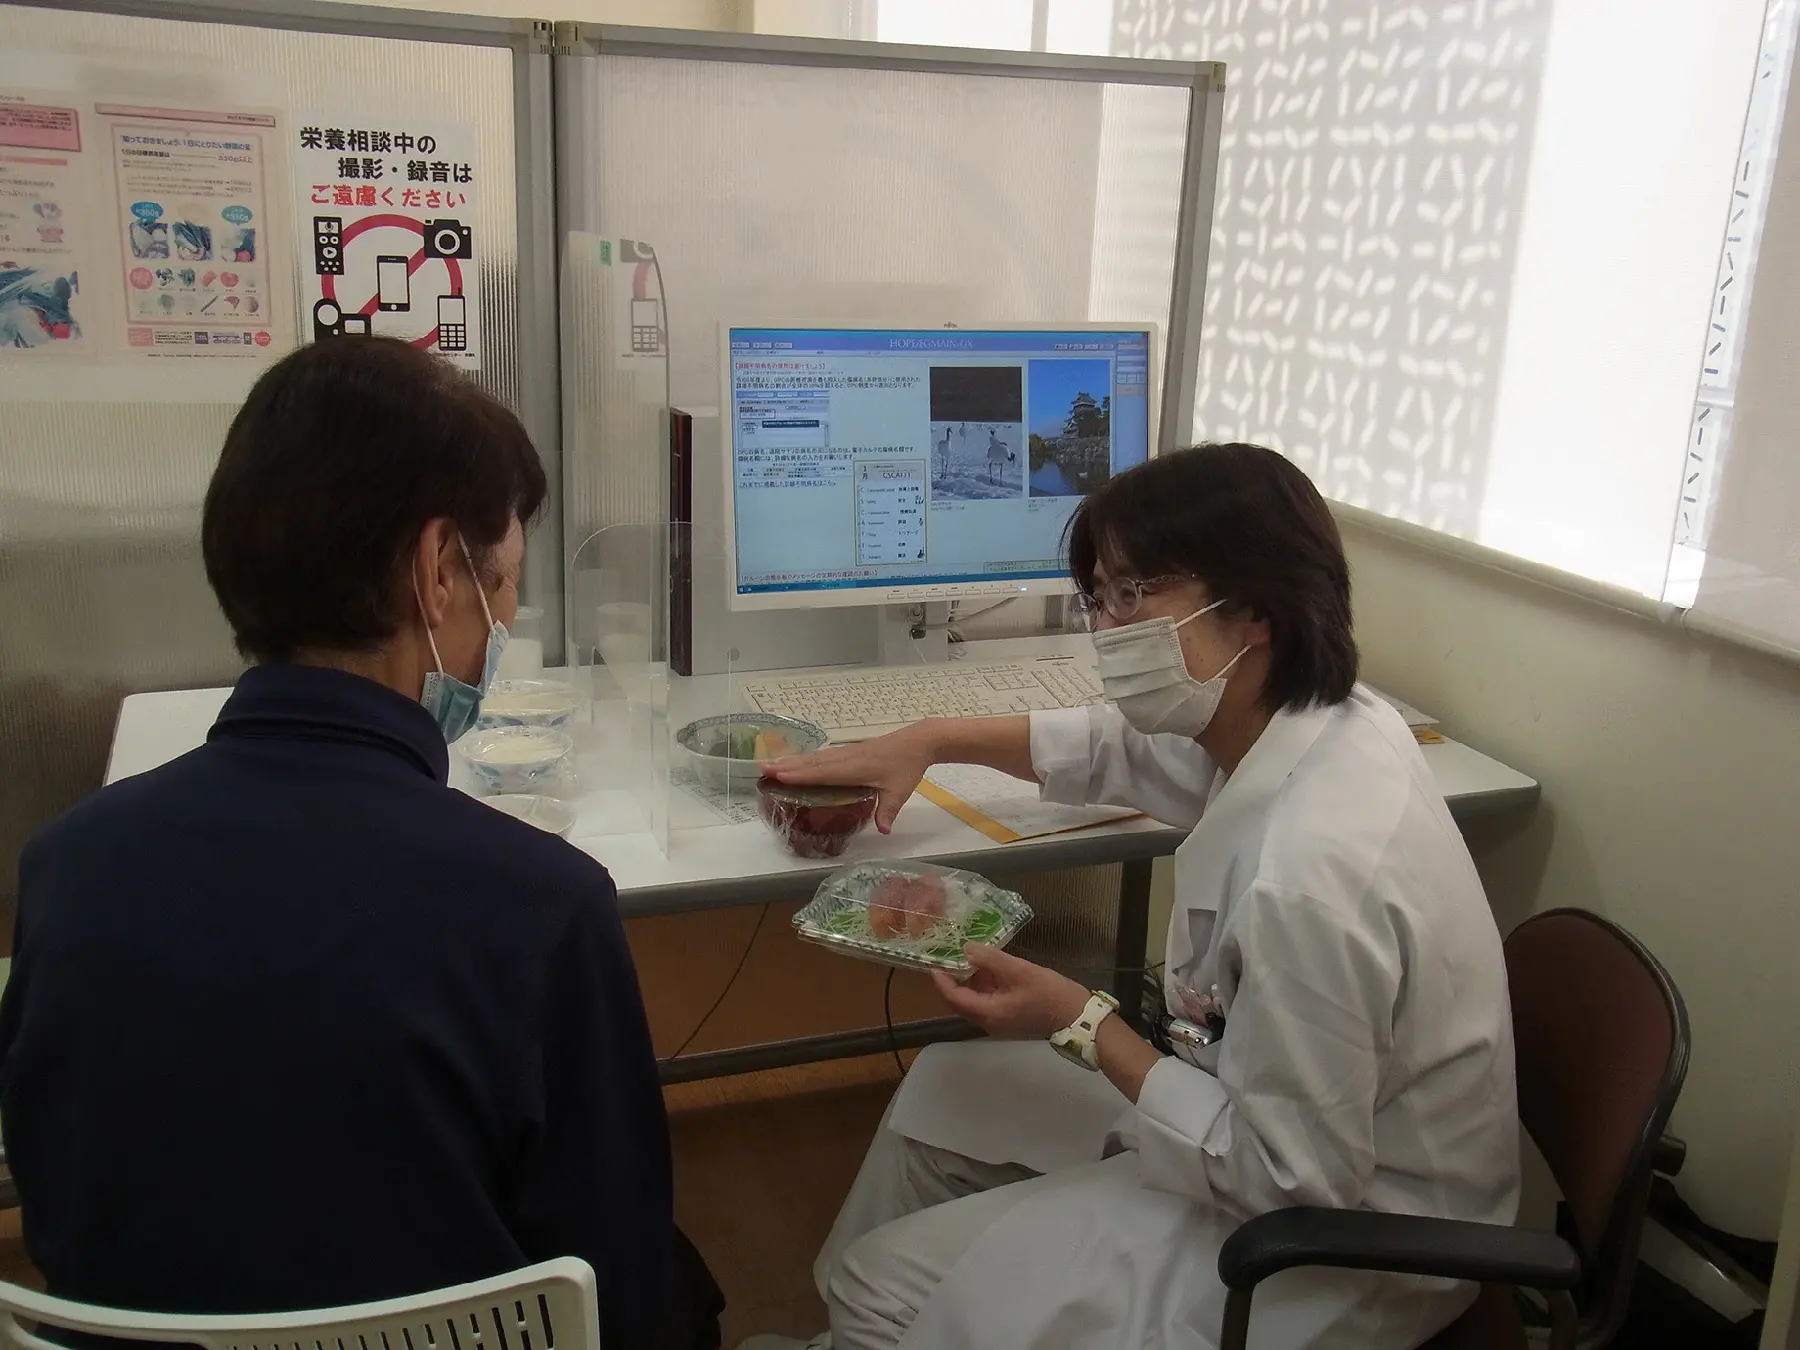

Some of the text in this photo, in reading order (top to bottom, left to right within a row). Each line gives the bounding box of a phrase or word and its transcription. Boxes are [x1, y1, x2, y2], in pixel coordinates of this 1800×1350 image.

[300, 127, 437, 154] 栄養相談中の
[338, 157, 473, 183] 撮影・録音は
[311, 184, 466, 209] ご遠慮ください
